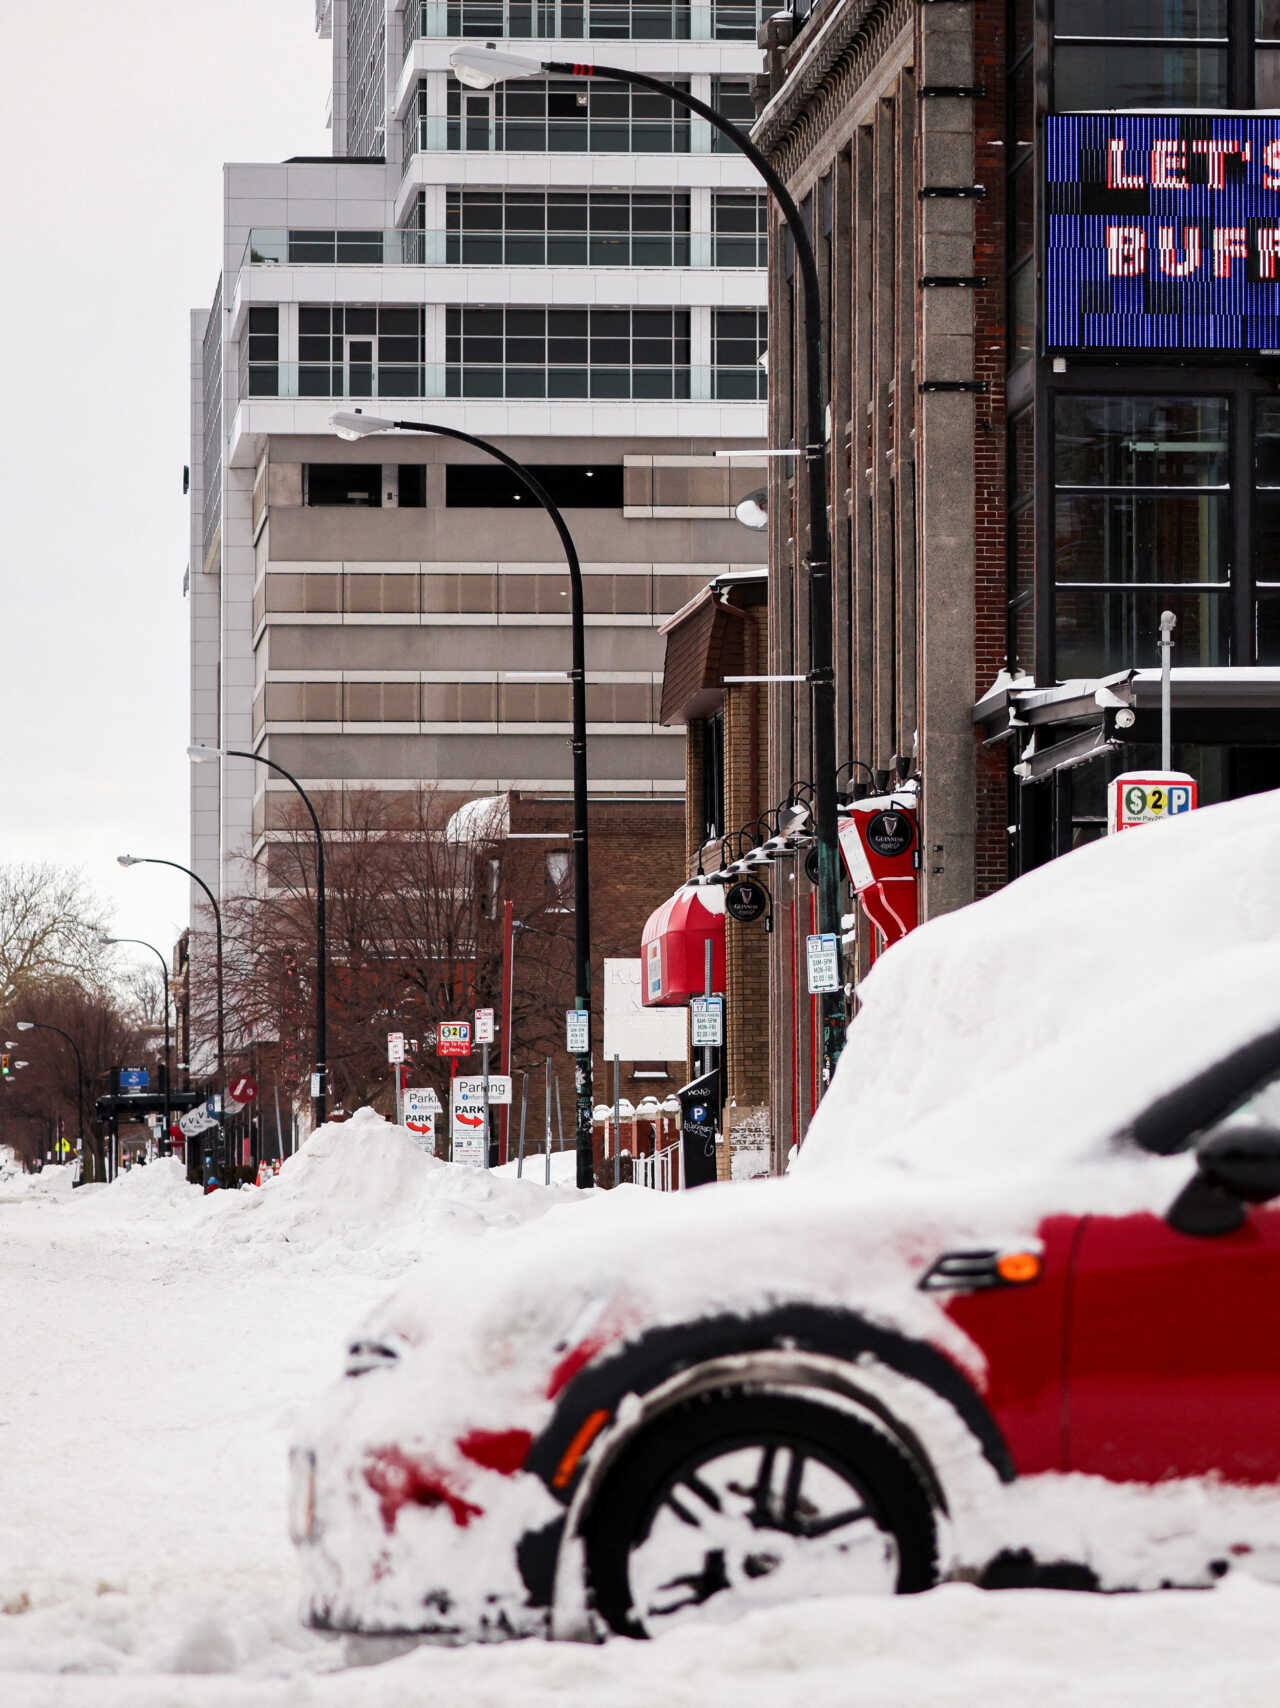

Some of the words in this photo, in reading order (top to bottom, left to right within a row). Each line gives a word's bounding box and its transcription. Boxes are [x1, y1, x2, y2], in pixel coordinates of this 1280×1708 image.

[455, 1105, 485, 1114] PARK
[693, 1107, 704, 1120] P
[405, 1114, 432, 1122] PARK
